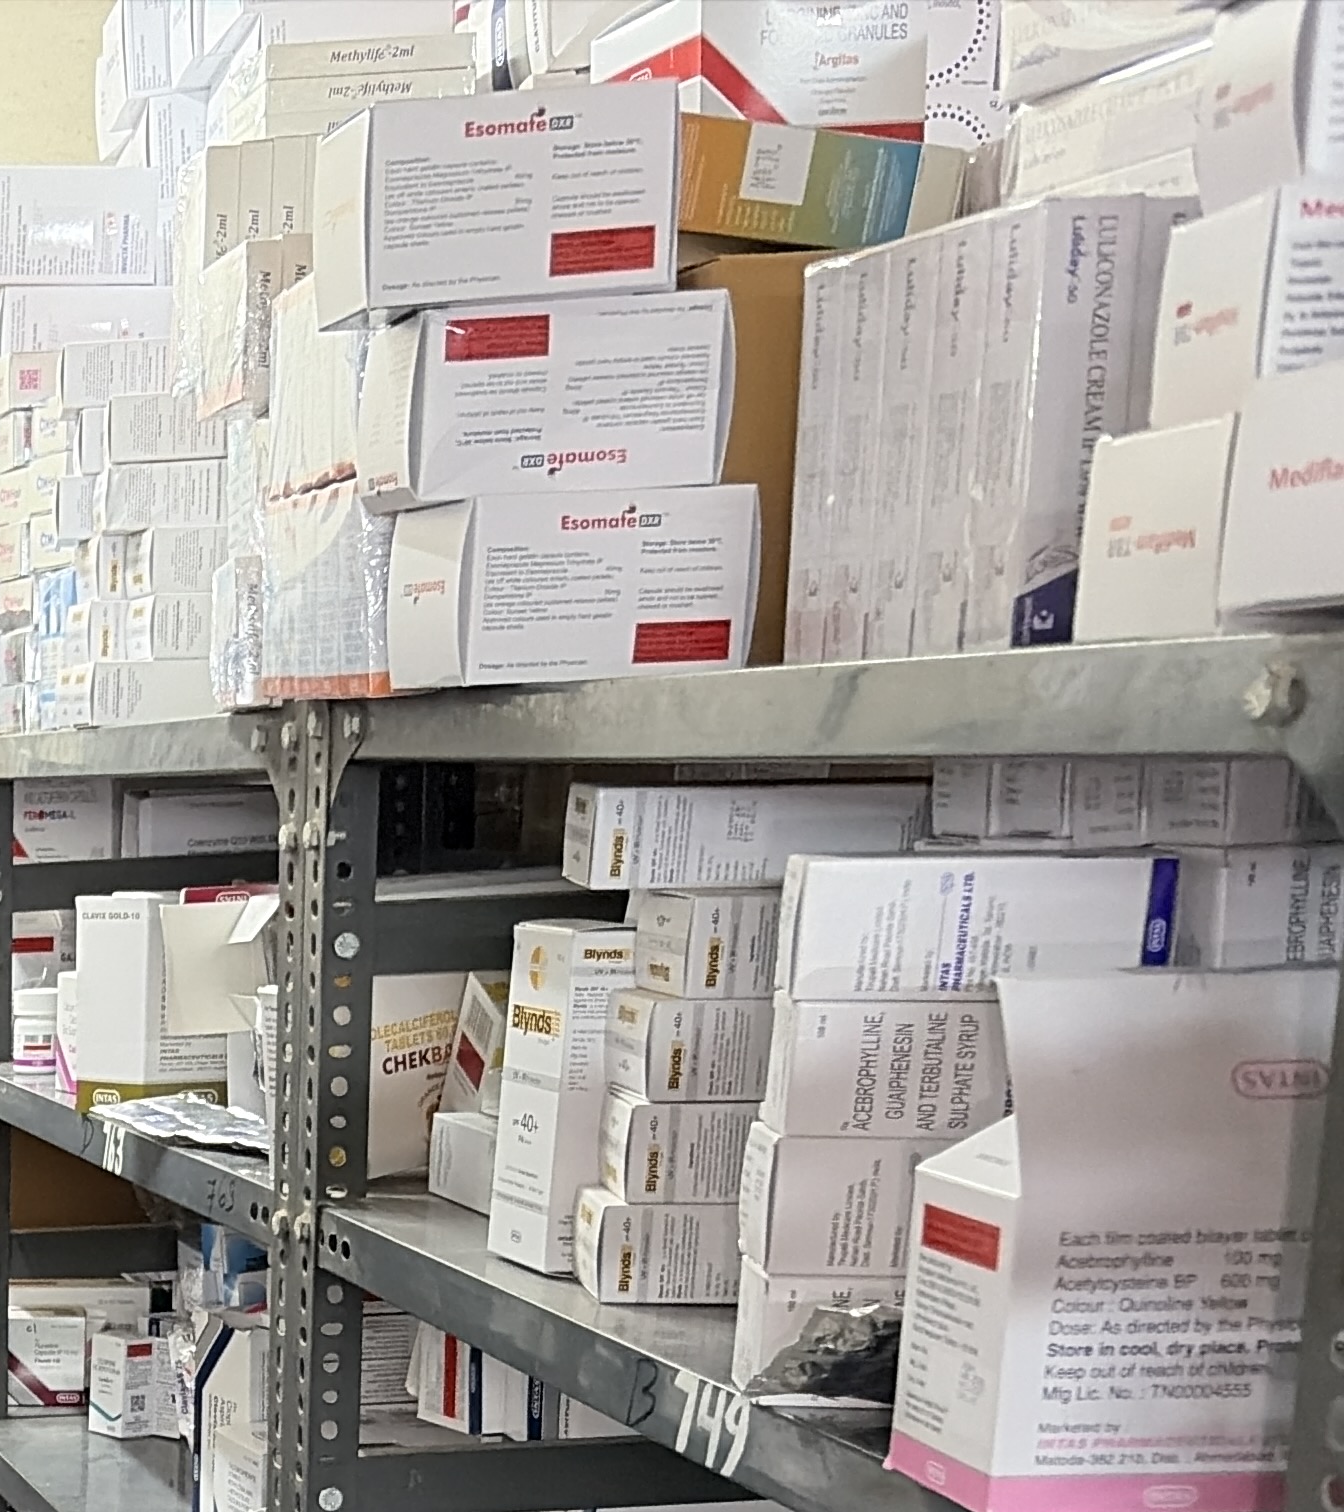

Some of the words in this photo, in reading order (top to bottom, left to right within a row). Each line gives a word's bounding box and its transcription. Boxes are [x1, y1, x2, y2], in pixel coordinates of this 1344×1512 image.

[584, 947, 624, 961] Blynds
[950, 893, 974, 992] PHARMACEUTICALS
[939, 962, 951, 992] INTAS
[512, 1006, 553, 1035] Blynds
[961, 1014, 979, 1058] SYRUP
[668, 1045, 682, 1091] Blynds
[852, 1012, 885, 1133] ACEBROPHYLLINE,
[885, 1022, 914, 1121] GUAIPHENESIN
[919, 1012, 949, 1097] TERBUTALINE
[917, 1100, 937, 1131] AND
[948, 1062, 975, 1130] SULPHATE
[519, 1113, 540, 1133] 40+
[644, 1148, 659, 1194] Blynds
[618, 1251, 632, 1294] Blynds
[1100, 1320, 1123, 1335] As
[1126, 1319, 1189, 1334] directed
[1046, 1343, 1093, 1358] Store
[1043, 1365, 1083, 1382] Keep
[674, 1372, 750, 1478] 749
